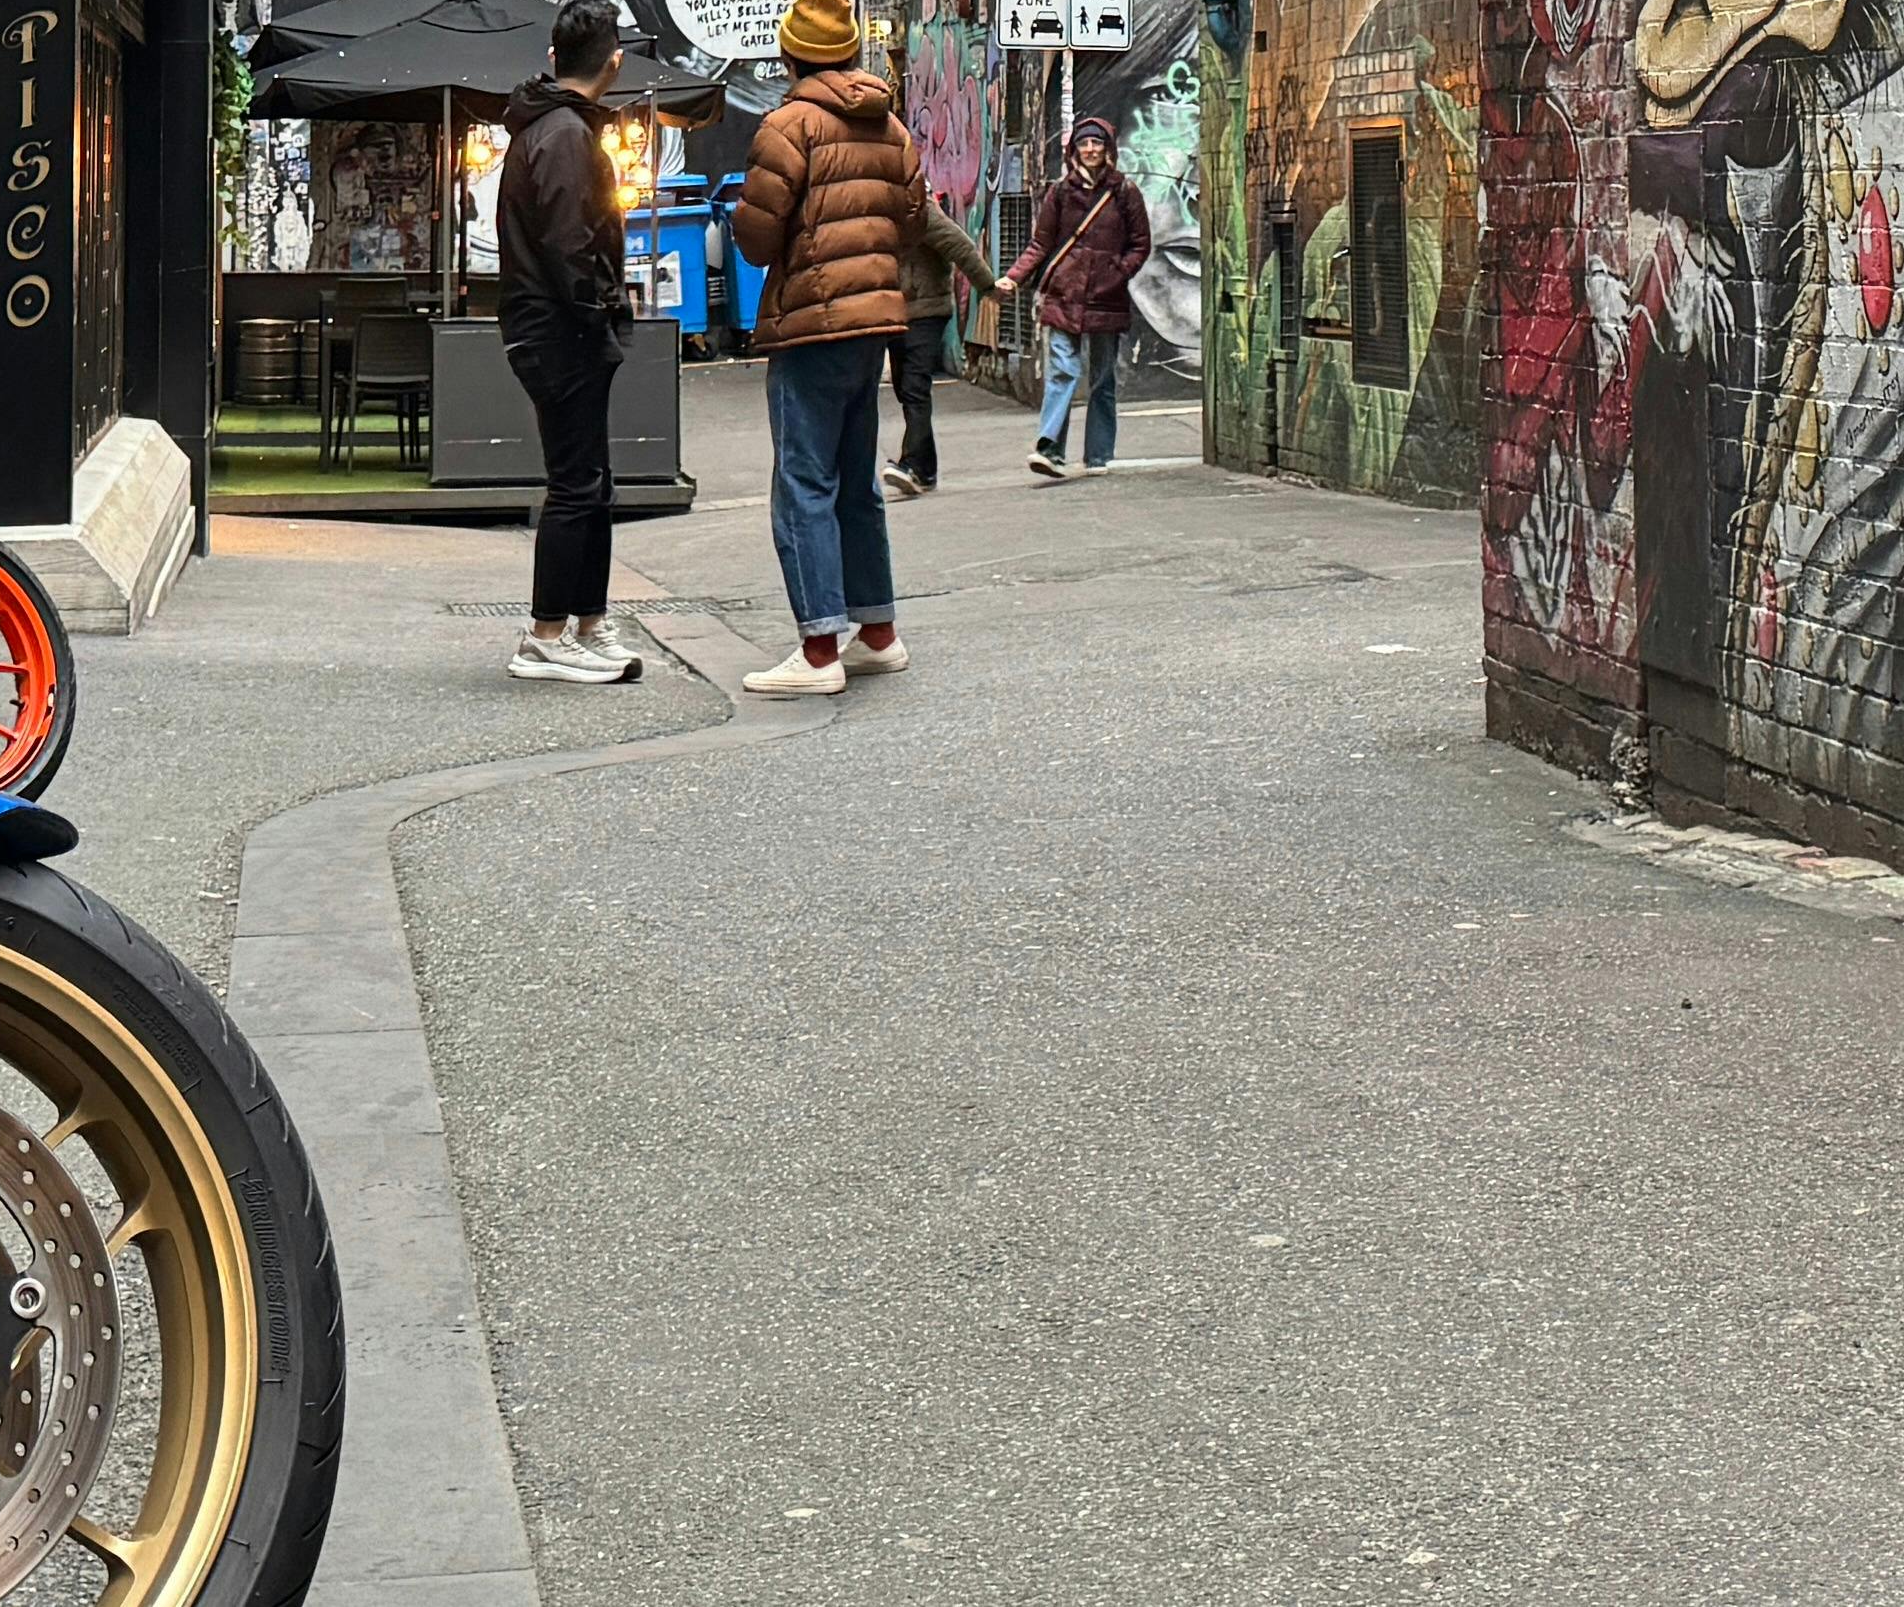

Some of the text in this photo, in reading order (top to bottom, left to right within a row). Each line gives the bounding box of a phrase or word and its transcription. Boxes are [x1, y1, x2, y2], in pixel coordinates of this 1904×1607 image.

[707, 22, 728, 38] LET
[732, 20, 750, 33] ME
[741, 33, 775, 48] GATES
[0, 9, 59, 328] PISCO
